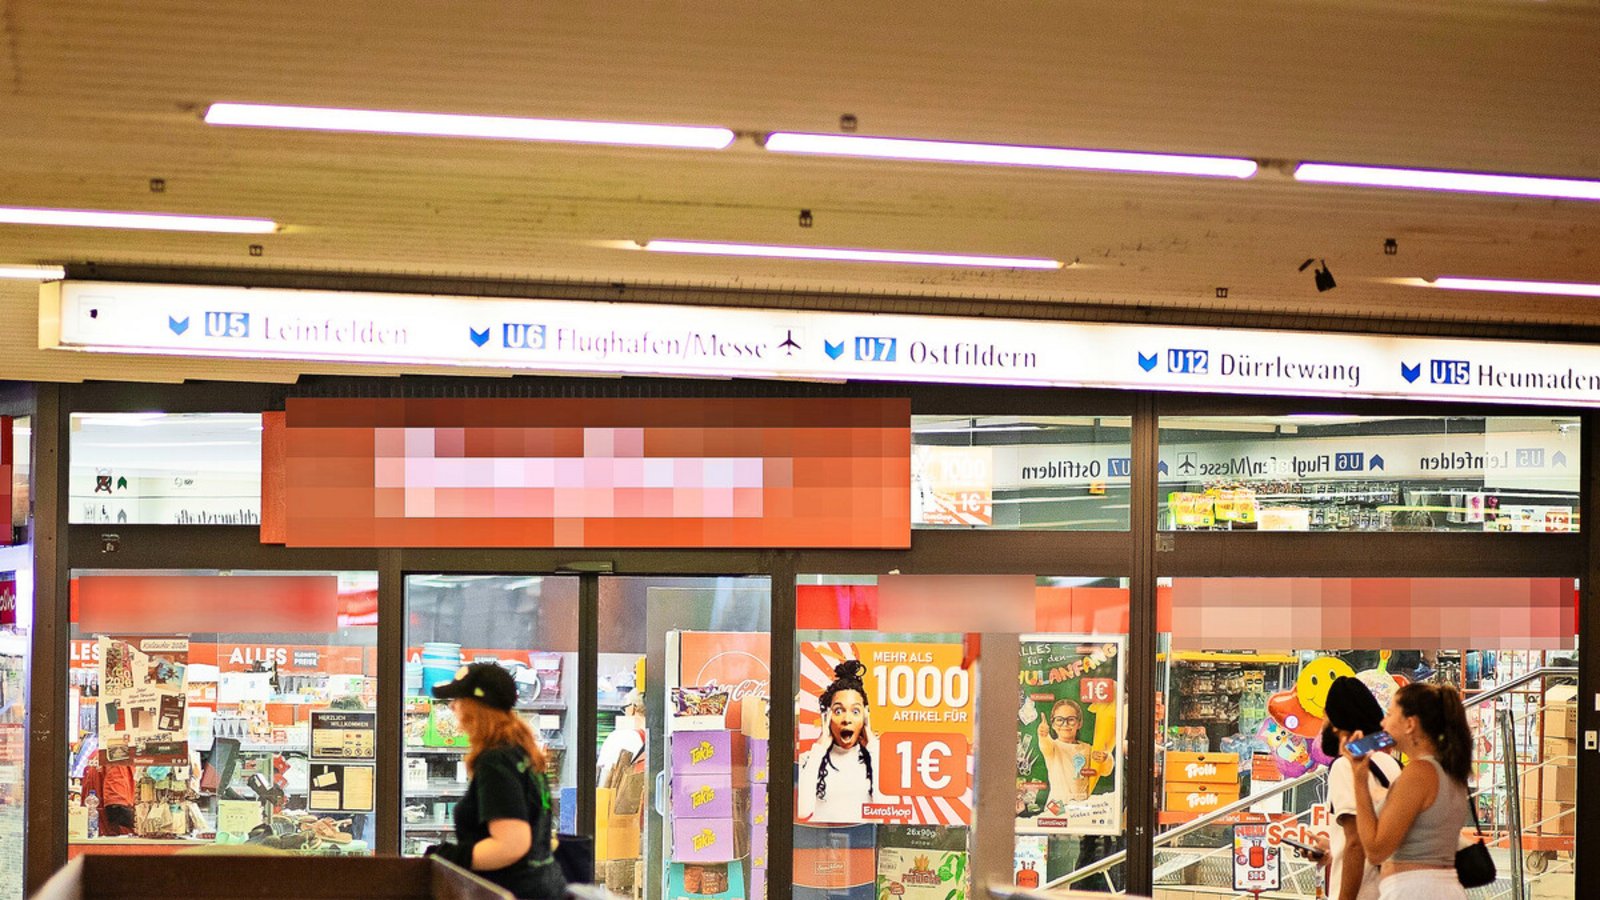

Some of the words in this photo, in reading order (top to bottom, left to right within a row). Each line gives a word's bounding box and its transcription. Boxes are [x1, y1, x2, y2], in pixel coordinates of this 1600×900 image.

[206, 312, 249, 338] U5
[264, 316, 408, 346] Leinfelden
[504, 324, 546, 349] U6
[557, 328, 767, 359] Flughafen/Messe
[856, 337, 896, 361] U7
[909, 340, 1037, 368] Ostfildern
[1168, 349, 1209, 375] U12
[1220, 353, 1361, 388] Dürrlewang
[1431, 360, 1470, 385] U15
[1478, 365, 1600, 391] Heumaden
[961, 493, 981, 512] 1€
[229, 647, 287, 665] ALLES
[873, 652, 906, 663] MEHR
[908, 652, 933, 663] ALS
[1019, 643, 1052, 656] LLES
[1027, 655, 1043, 667] für
[1048, 654, 1066, 663] den
[873, 664, 970, 708] 1000
[1087, 681, 1109, 700] 1€
[318, 714, 346, 722] HERZLICH
[330, 720, 369, 728] WILLKOMMEN
[893, 711, 941, 722] ARTIKEL
[943, 710, 968, 722] FÜR
[896, 740, 952, 790] 1€
[1184, 762, 1217, 778] Trolli
[1185, 793, 1219, 808] Trolli
